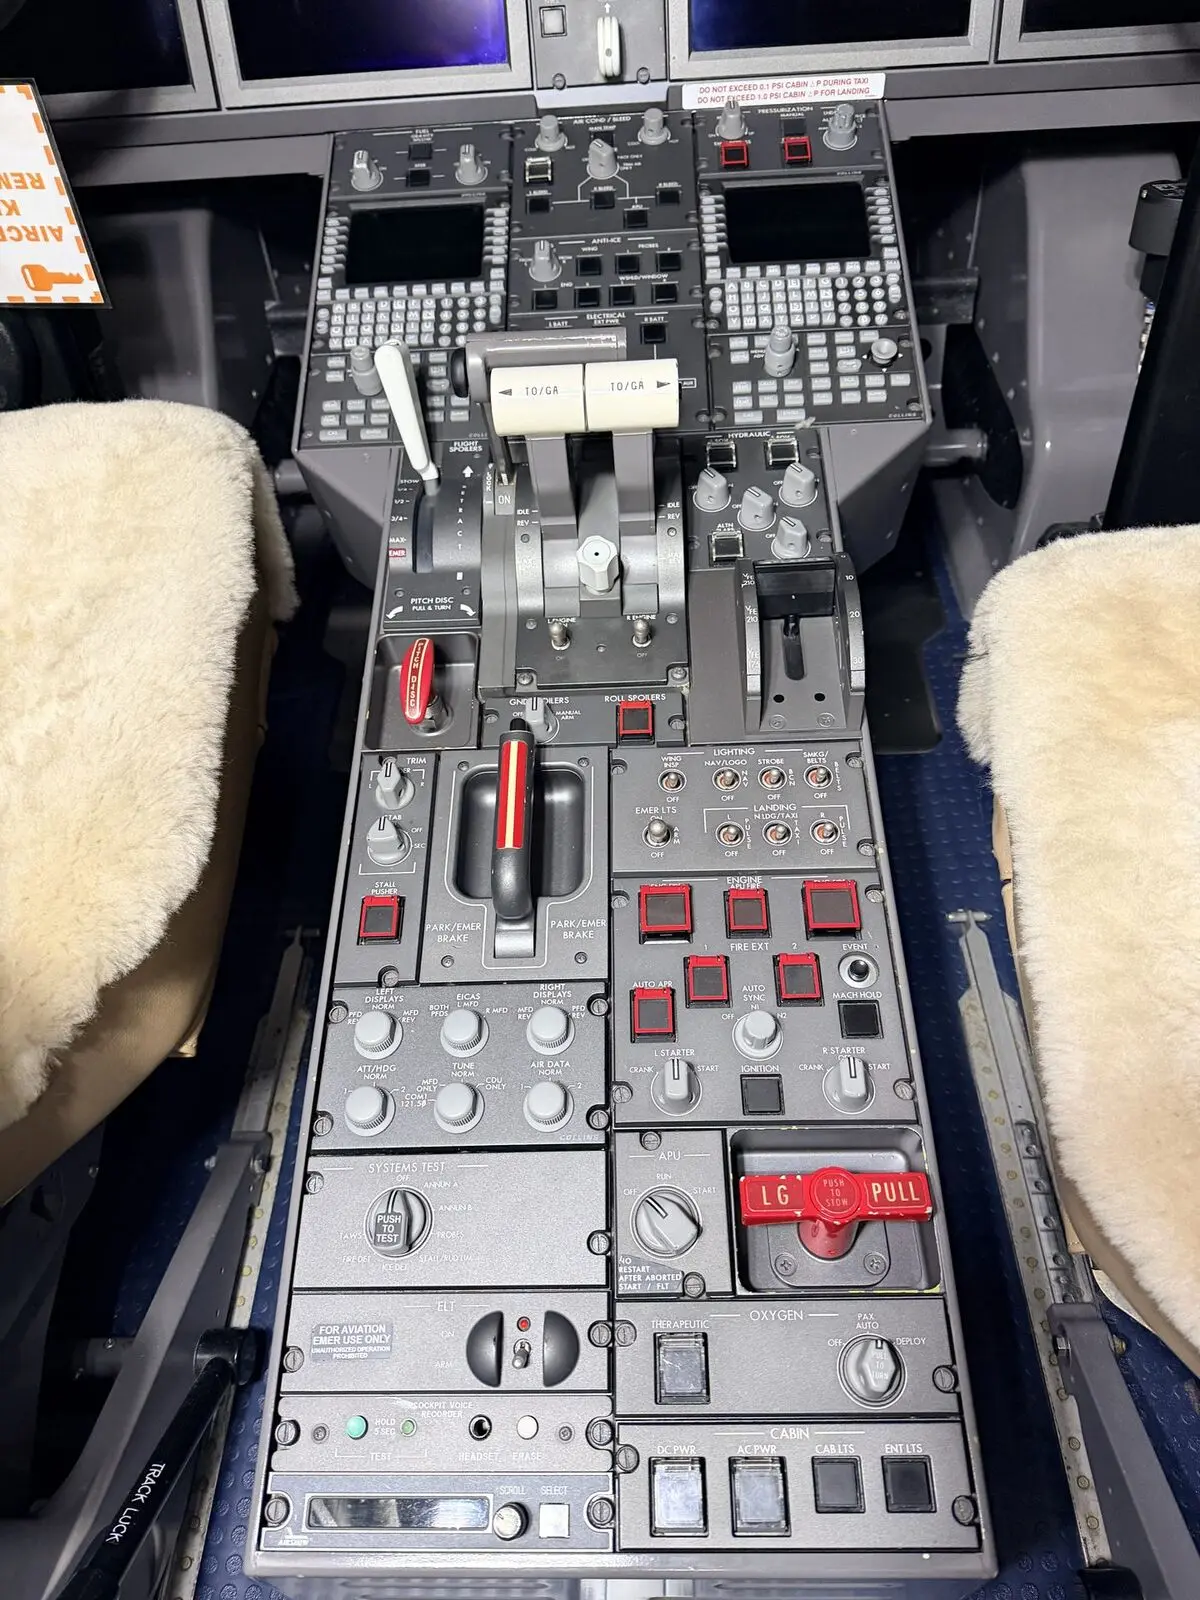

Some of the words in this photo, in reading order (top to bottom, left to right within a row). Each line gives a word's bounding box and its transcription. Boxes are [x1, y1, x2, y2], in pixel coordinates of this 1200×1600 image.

[729, 84, 758, 92] EXCEED
[785, 81, 808, 89] CABIN
[783, 90, 805, 98] CABIN
[837, 87, 870, 95] LANDING
[610, 381, 644, 391] TO/GA
[525, 387, 559, 395] TO/GA
[498, 495, 511, 504] ON
[727, 876, 762, 884] ENGINE
[426, 923, 481, 931] PARK/EMER
[551, 920, 606, 928] PARK/EMER
[437, 934, 468, 942] BRAKE
[563, 931, 594, 939] BRAKE
[731, 943, 749, 951] FIRE
[751, 942, 768, 950] EXT
[659, 1152, 681, 1160] APU
[369, 1163, 417, 1173] SYSTEMS
[421, 1162, 445, 1172] TEST
[823, 1179, 844, 1187] PUSH
[830, 1189, 841, 1197] TO
[872, 1181, 919, 1202] PULL
[826, 1199, 848, 1207] STOW
[378, 1215, 401, 1223] PUSH
[383, 1225, 394, 1233] TO
[376, 1234, 399, 1242] TEST
[749, 1310, 804, 1321] OXYGEN
[320, 1325, 340, 1334] FOR
[342, 1324, 385, 1334] AVIATION
[652, 1320, 709, 1329] THERAPEUTIC
[313, 1336, 340, 1345] EMER
[343, 1336, 362, 1344] USE
[365, 1335, 390, 1344] ONLY
[896, 1338, 926, 1346] DEPLOY
[770, 1428, 809, 1440] CABIN
[657, 1445, 671, 1455] DC
[674, 1445, 696, 1454] PWR
[738, 1445, 751, 1454] AC
[754, 1445, 776, 1454] PWR
[816, 1444, 836, 1454] CAB
[838, 1444, 855, 1454] LTS
[885, 1444, 904, 1453] ENT
[907, 1443, 923, 1453] LTS
[132, 1462, 166, 1504] TRACK
[106, 1507, 140, 1543] LUCK
